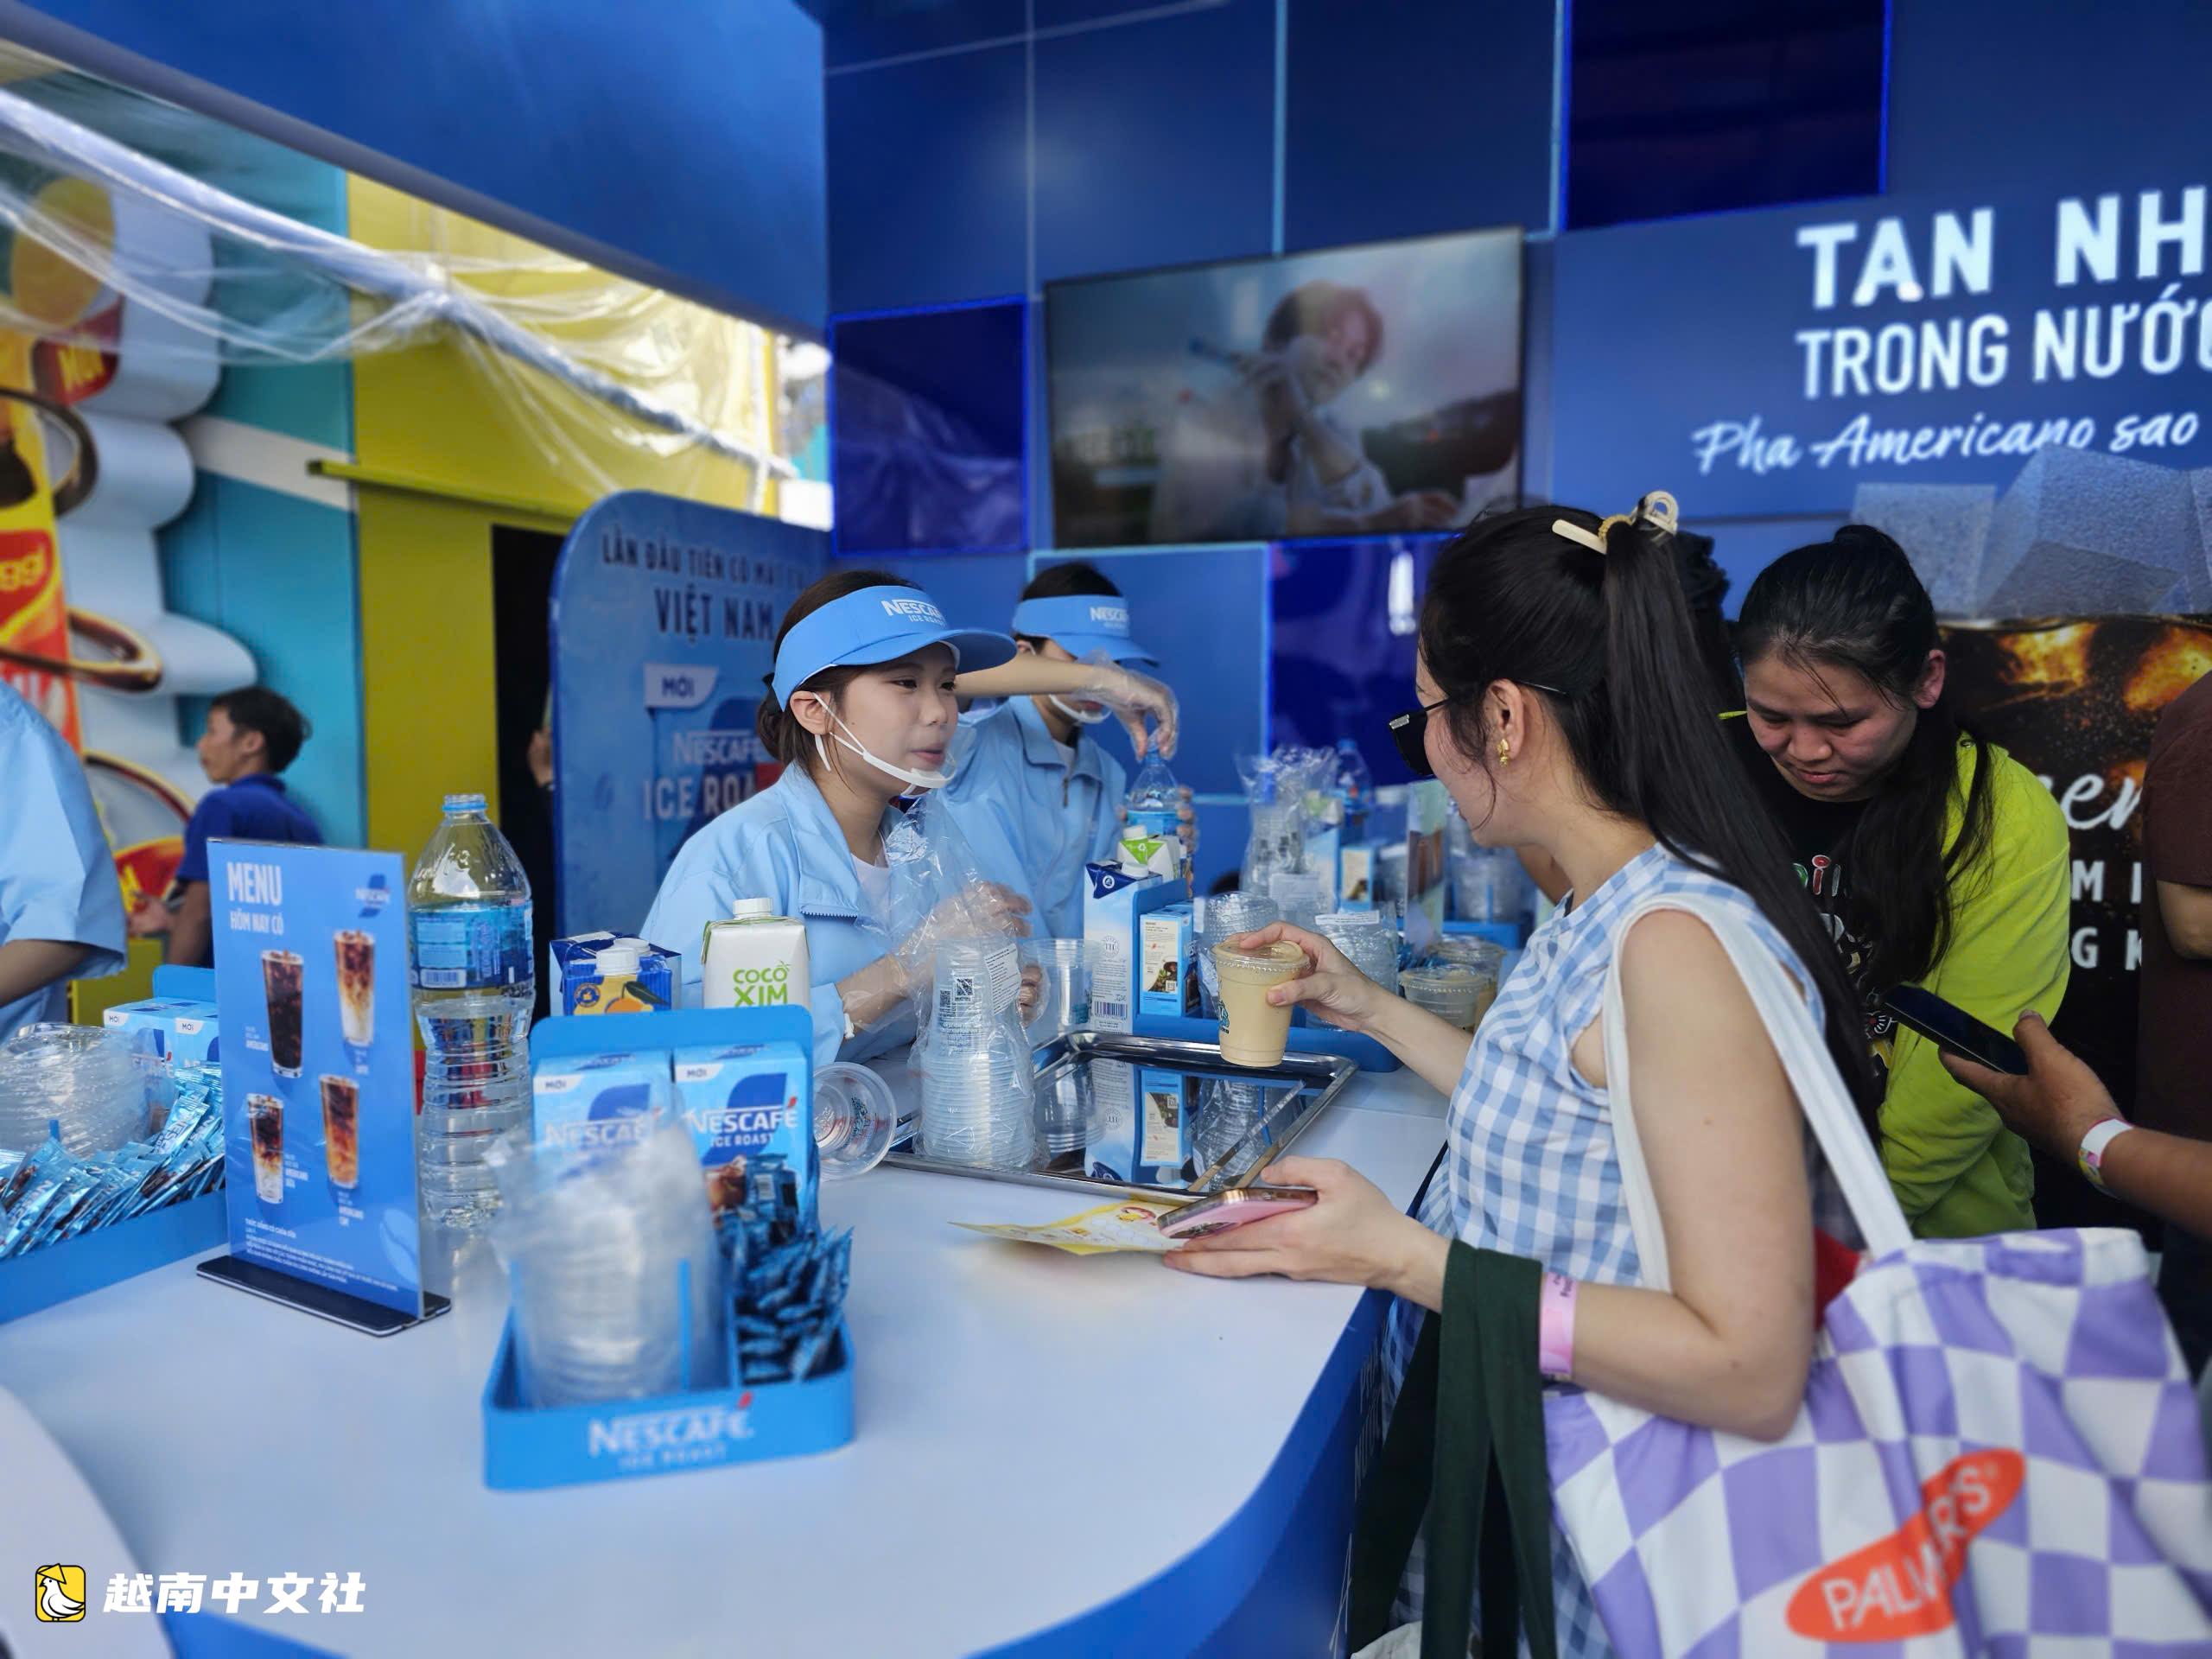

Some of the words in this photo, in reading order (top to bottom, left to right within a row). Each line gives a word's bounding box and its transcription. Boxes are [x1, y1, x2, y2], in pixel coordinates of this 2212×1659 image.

[1796, 208, 1994, 309] TAN
[1795, 315, 2010, 400] TRONG
[1692, 415, 1802, 475] Pha
[1811, 413, 2094, 467] Americano
[2108, 412, 2199, 453] sao
[654, 582, 713, 644] VIỆT
[724, 596, 775, 642] NAM
[643, 772, 694, 821] ICE
[227, 861, 283, 906] MENU
[734, 983, 788, 1007] XIM
[710, 1135, 736, 1148] ICE
[741, 1132, 774, 1147] ROAST
